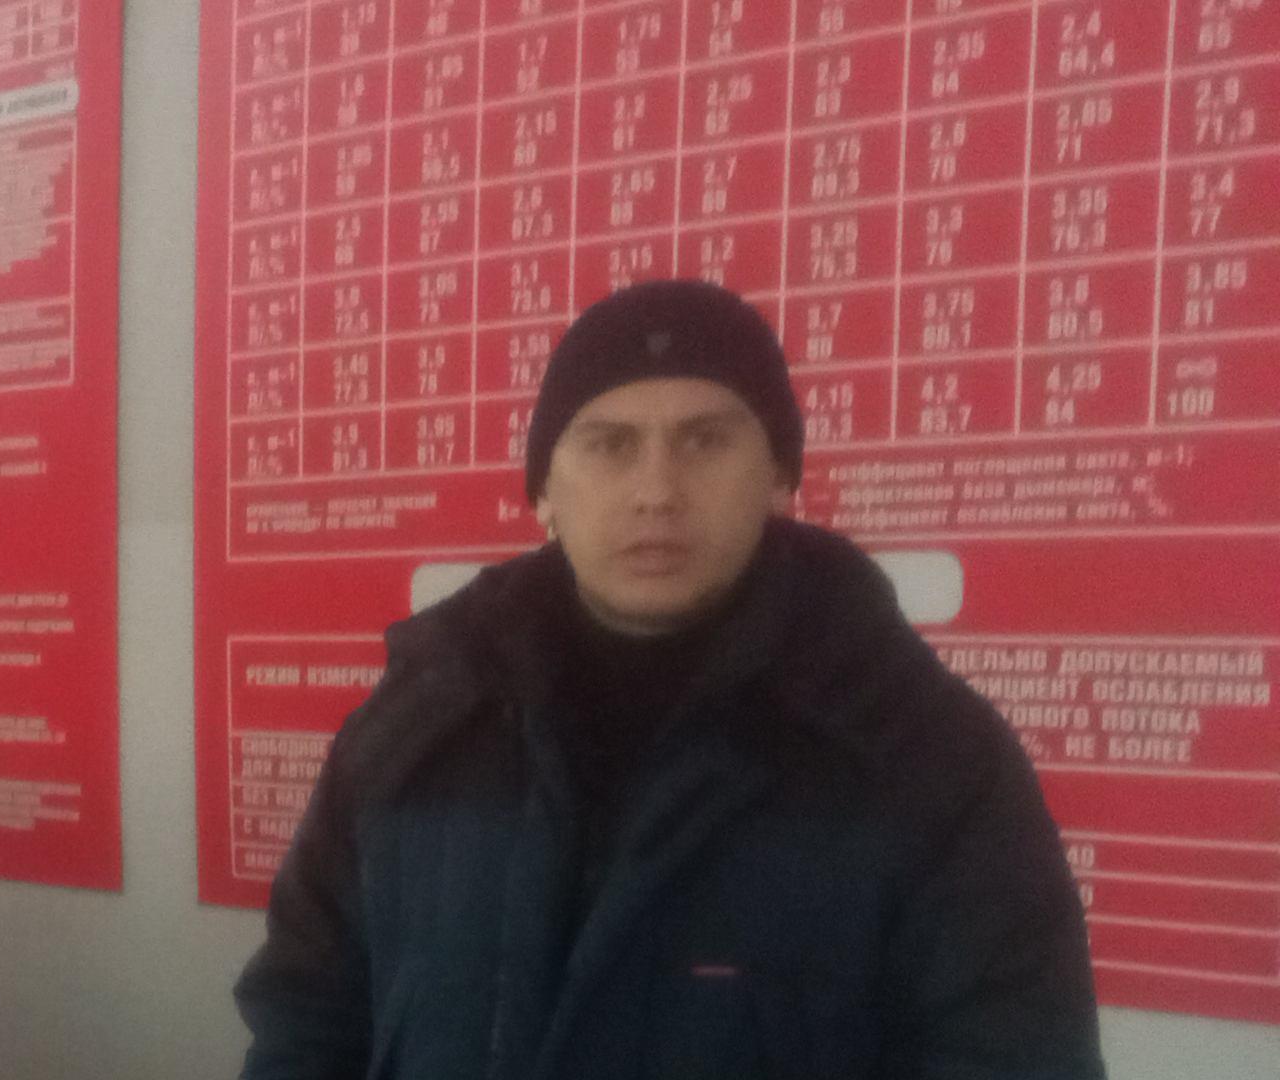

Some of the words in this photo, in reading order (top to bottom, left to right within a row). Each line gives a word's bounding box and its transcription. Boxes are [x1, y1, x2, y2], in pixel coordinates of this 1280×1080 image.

[1061, 10, 1101, 43] 2,4
[1059, 38, 1115, 77] 64,4
[1056, 133, 1082, 164] 71
[1191, 168, 1234, 201] 3,4
[1190, 204, 1222, 238] 77
[921, 374, 958, 403] 4,2
[1168, 387, 1214, 416] 100
[246, 665, 300, 686] РЕЖИМ
[1058, 650, 1263, 676] ДОПУСКАЕМЫЙ
[1092, 680, 1270, 707] ОСЛАБЛЕНИЯ
[1101, 708, 1201, 734] ПОТОКА
[1066, 734, 1095, 758] НЕ
[1108, 736, 1191, 762] БОЛЕЕ
